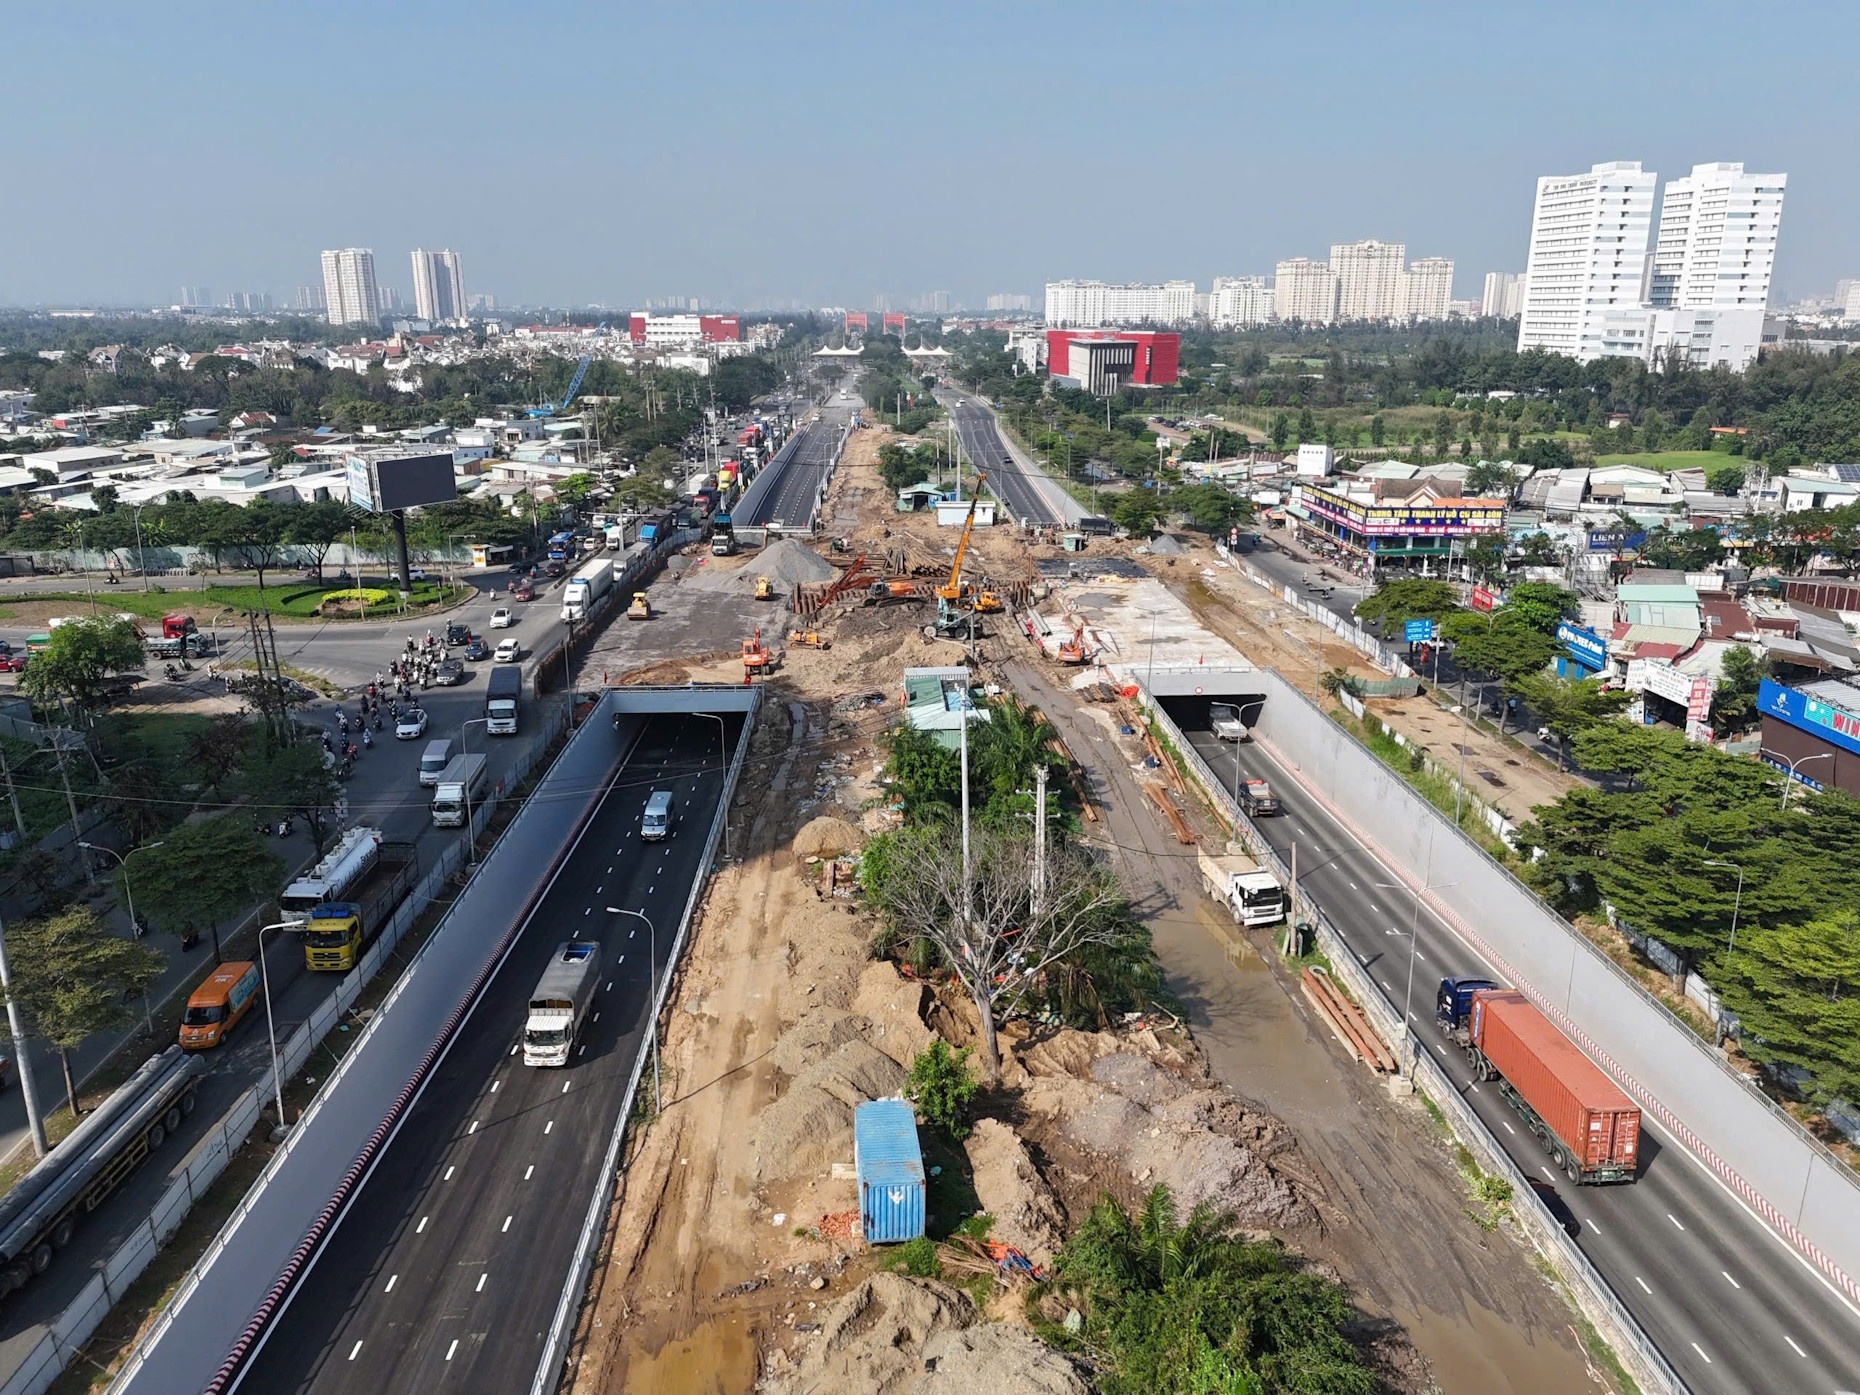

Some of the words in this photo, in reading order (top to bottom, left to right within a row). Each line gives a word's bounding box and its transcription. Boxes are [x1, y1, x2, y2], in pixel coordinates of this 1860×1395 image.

[1367, 510, 1392, 518] TRUNG
[1394, 509, 1410, 518] TÂM
[1412, 510, 1436, 518] THANH
[1437, 509, 1446, 518] LÝ
[1471, 509, 1485, 518] SÀI
[1833, 712, 1860, 737] WIN
